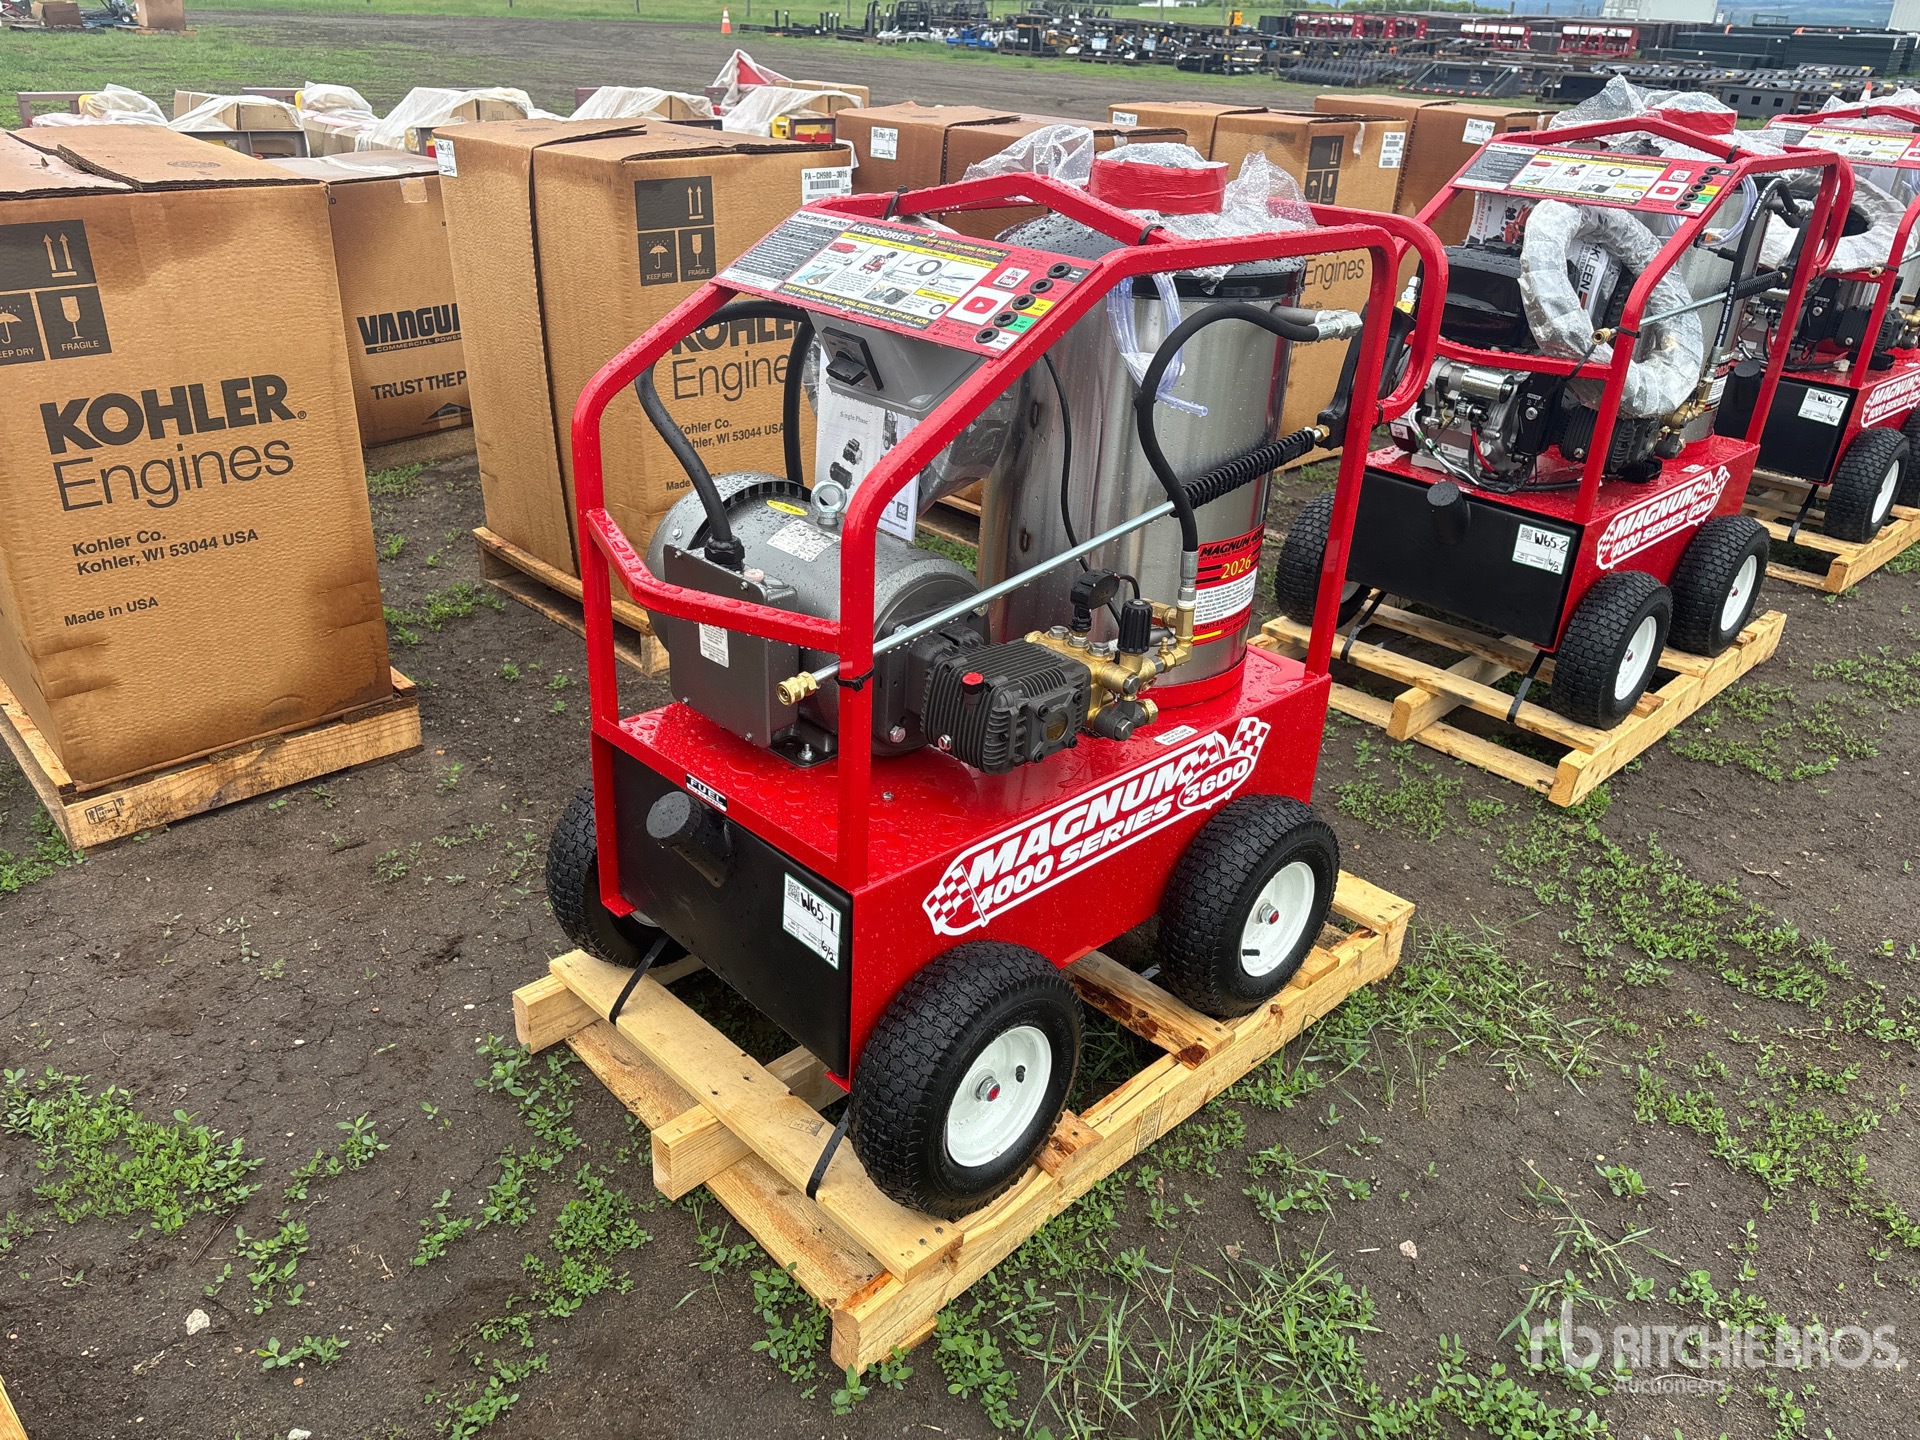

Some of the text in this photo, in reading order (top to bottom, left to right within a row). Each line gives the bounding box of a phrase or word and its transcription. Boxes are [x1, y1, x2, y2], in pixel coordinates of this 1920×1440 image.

[848, 223, 916, 242] ACCESSORIES
[974, 247, 1009, 257] EFFICIENCY
[688, 267, 711, 276] FRAGILE
[869, 306, 886, 314] CALL
[16, 347, 34, 357] DRY
[61, 340, 100, 351] FRAGILE
[376, 339, 432, 352] COMMERCIAL
[370, 378, 424, 400] TRUST
[425, 371, 455, 391] THE
[672, 350, 791, 401] Engine
[714, 418, 732, 429] Co.
[840, 411, 869, 425] Single Phase
[716, 432, 730, 444] WI
[732, 426, 762, 441] 53044
[53, 440, 294, 511] Engines
[666, 479, 691, 491] Made
[1613, 480, 1709, 541] MAGNUM
[1640, 509, 1688, 542] SERIES
[1689, 495, 1718, 518] GOLD
[72, 530, 167, 557] Kohler Co.
[76, 528, 259, 576] Kohler, WI 53044 USA
[1200, 537, 1250, 557] MAGNUM
[1534, 532, 1568, 552] W65-2
[1221, 554, 1251, 580] 2026
[64, 596, 159, 627] Made in USA
[691, 779, 723, 804] FUEL
[967, 741, 1214, 888] MAGNUM
[972, 758, 1248, 914] 4000 SERIES 3600
[801, 892, 834, 933] W65-1
